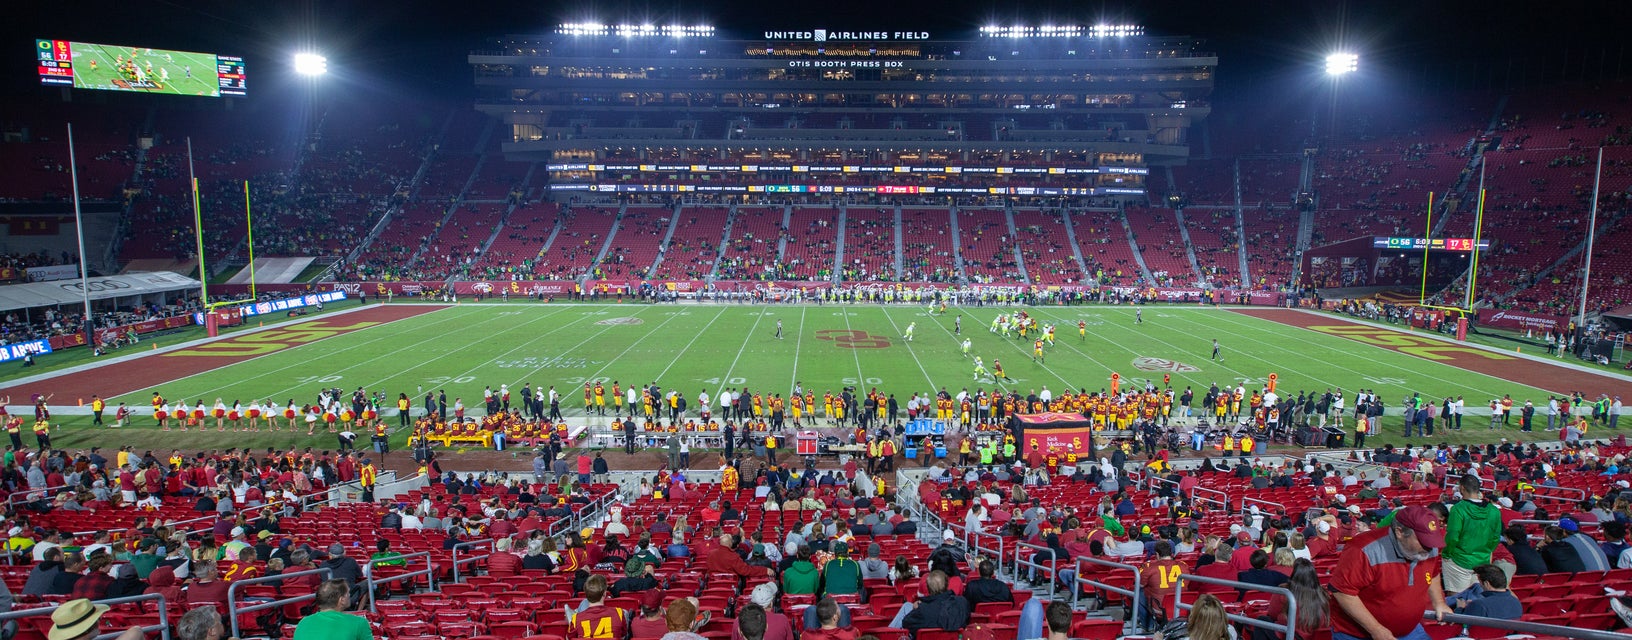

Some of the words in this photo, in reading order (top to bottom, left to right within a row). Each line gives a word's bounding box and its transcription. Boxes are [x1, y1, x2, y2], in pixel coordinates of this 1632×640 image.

[765, 31, 812, 39] UNITED
[828, 31, 888, 40] AIRLINES
[894, 31, 930, 40] FIELD
[160, 321, 383, 357] USC
[1306, 326, 1519, 360] USC
[703, 377, 747, 385] 40
[1073, 437, 1082, 449] SC
[1158, 564, 1185, 588] 14
[581, 616, 614, 638] 14
